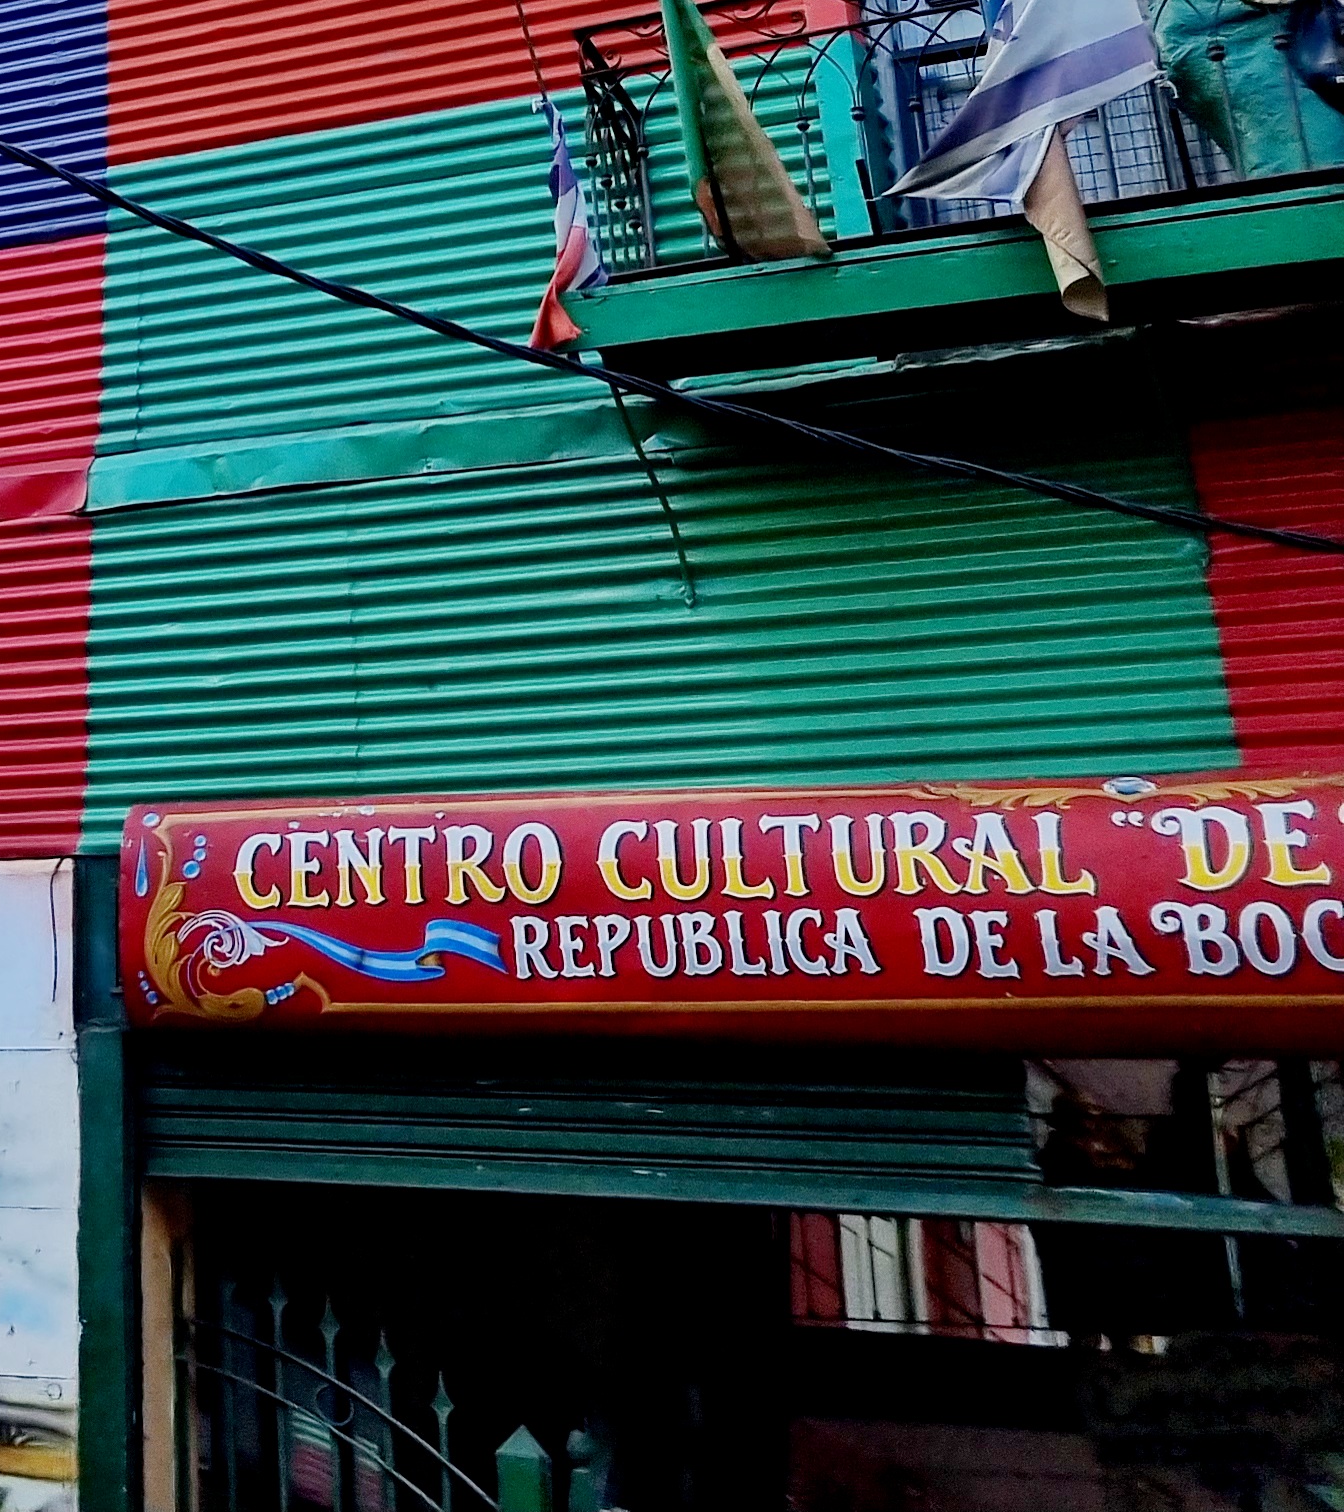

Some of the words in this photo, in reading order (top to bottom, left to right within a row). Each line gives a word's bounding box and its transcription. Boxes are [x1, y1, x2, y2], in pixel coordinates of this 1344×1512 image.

[233, 821, 562, 909] CENTRO
[596, 810, 1097, 900] CULTURAL
[509, 907, 882, 980] REPUBLICA
[913, 905, 1022, 979] DE
[1033, 905, 1156, 976] LA
